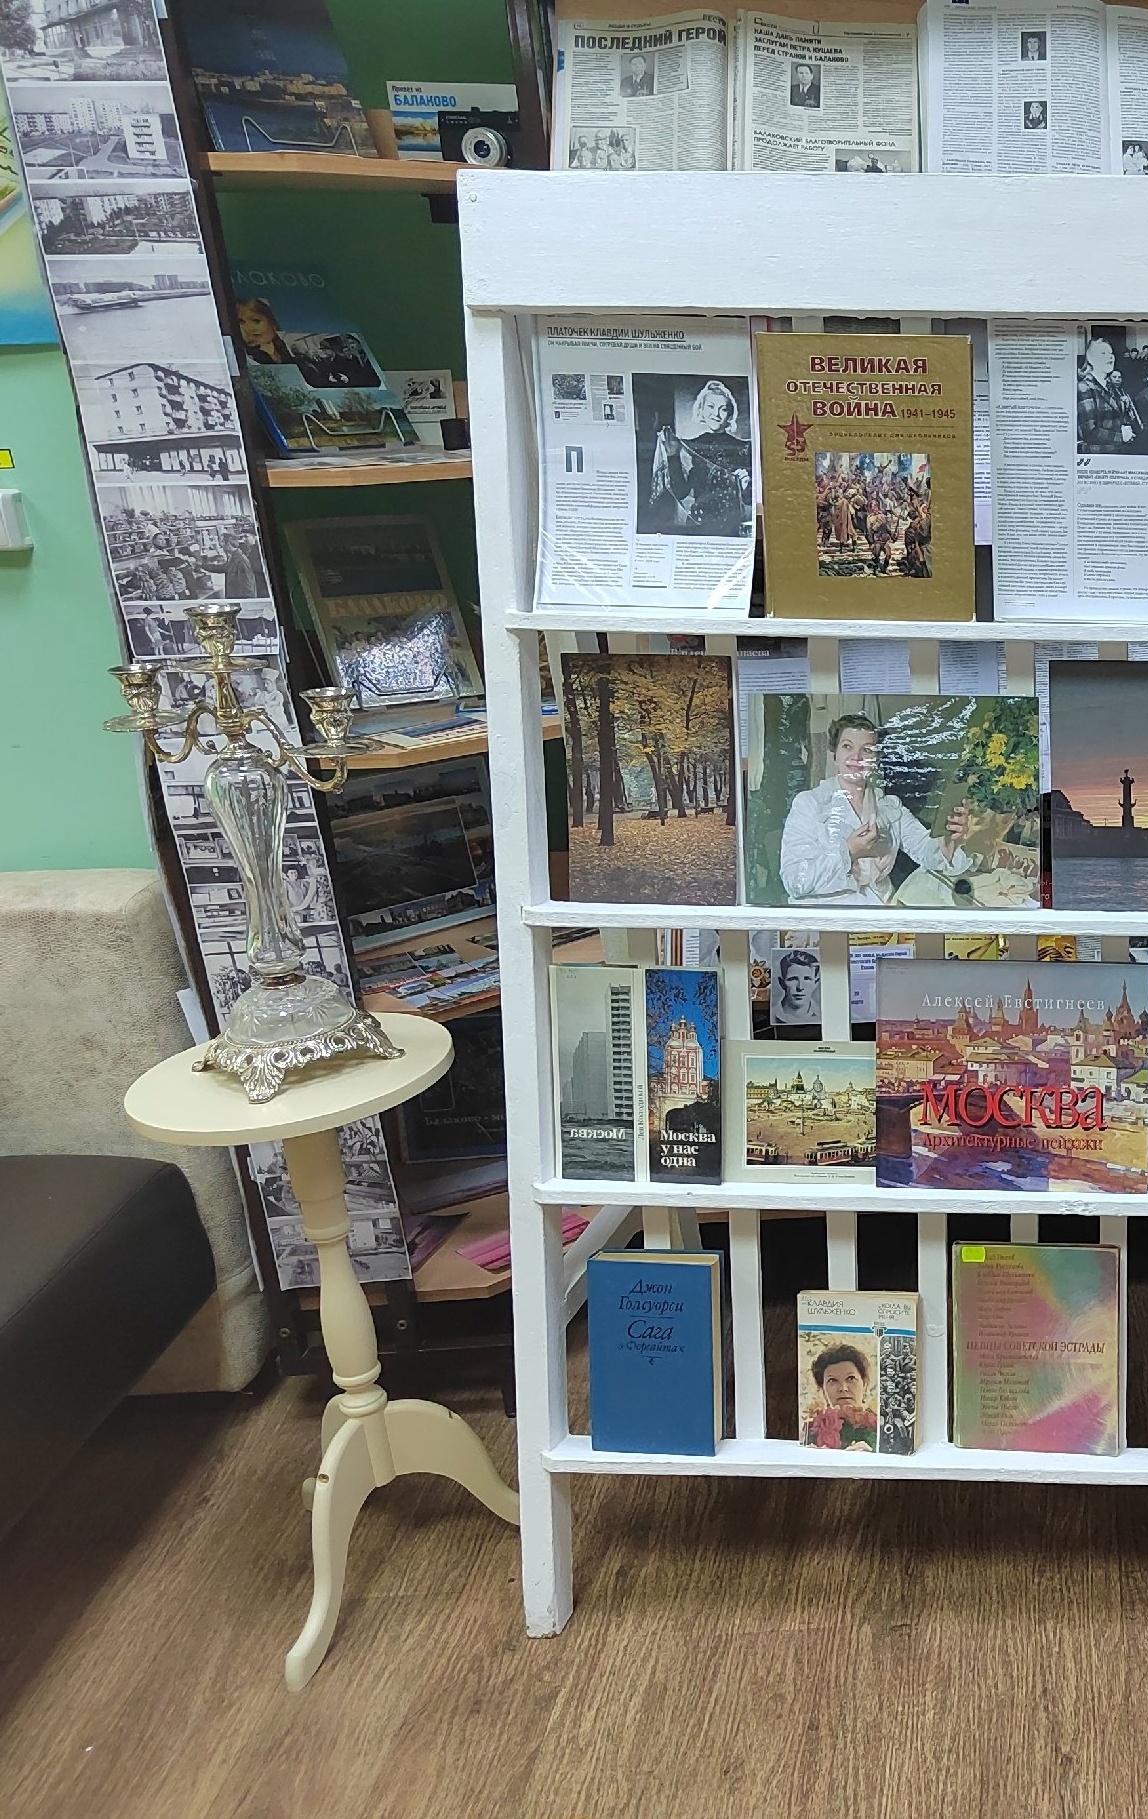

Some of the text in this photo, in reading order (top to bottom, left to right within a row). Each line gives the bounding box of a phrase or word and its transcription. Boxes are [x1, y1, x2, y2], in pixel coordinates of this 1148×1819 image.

[574, 26, 727, 51] ПОСЛЕДНИЙ ГЕРОЙ
[753, 37, 789, 49] ЗАСЛУГАМ
[790, 43, 811, 52] ПЕТРА
[754, 28, 822, 45] НАША ДАНЬ ПАМЯТИ
[753, 45, 776, 55] ПЕРЕД
[777, 50, 807, 60] СТРАНОЙ
[814, 54, 849, 63] БАЛАКОВО
[393, 94, 457, 107] БАЛАКОВО
[753, 130, 802, 143] БАЛАКОВСКИЙ
[805, 138, 873, 147] БЛАГОТВОРИТЕЛЬНЫЙ
[753, 137, 826, 152] ПРОДОЛЖАЕТ РАБОТУ
[547, 326, 685, 339] ПЛАТОЧЕК КЛАВДИИ ШУЛЬЖЕНКО
[809, 355, 929, 374] ВЕЛИКАЯ
[786, 379, 943, 396] ОТЕЧЕСТВЕННАЯ
[812, 396, 899, 418] ВОЙНА
[565, 445, 584, 473] П
[921, 993, 1105, 1011] Алексей Евстигнеев
[660, 1129, 717, 1143] Москва
[923, 1132, 1104, 1152] Архитектурные пейзажи
[660, 1143, 700, 1155] у нас
[660, 1156, 697, 1168] одна
[629, 1278, 673, 1294] Джон
[617, 1295, 685, 1316] Голсуорси
[807, 1300, 844, 1308] КЛАВДИЯ
[807, 1308, 856, 1316] ШУЛЬЖЕНКО
[626, 1319, 675, 1341] Сага
[626, 1341, 686, 1355] Форсайтах
[1003, 1341, 1058, 1352] СОВЕТСКОЙ
[1060, 1341, 1106, 1354] ЭСТРАДЫ
